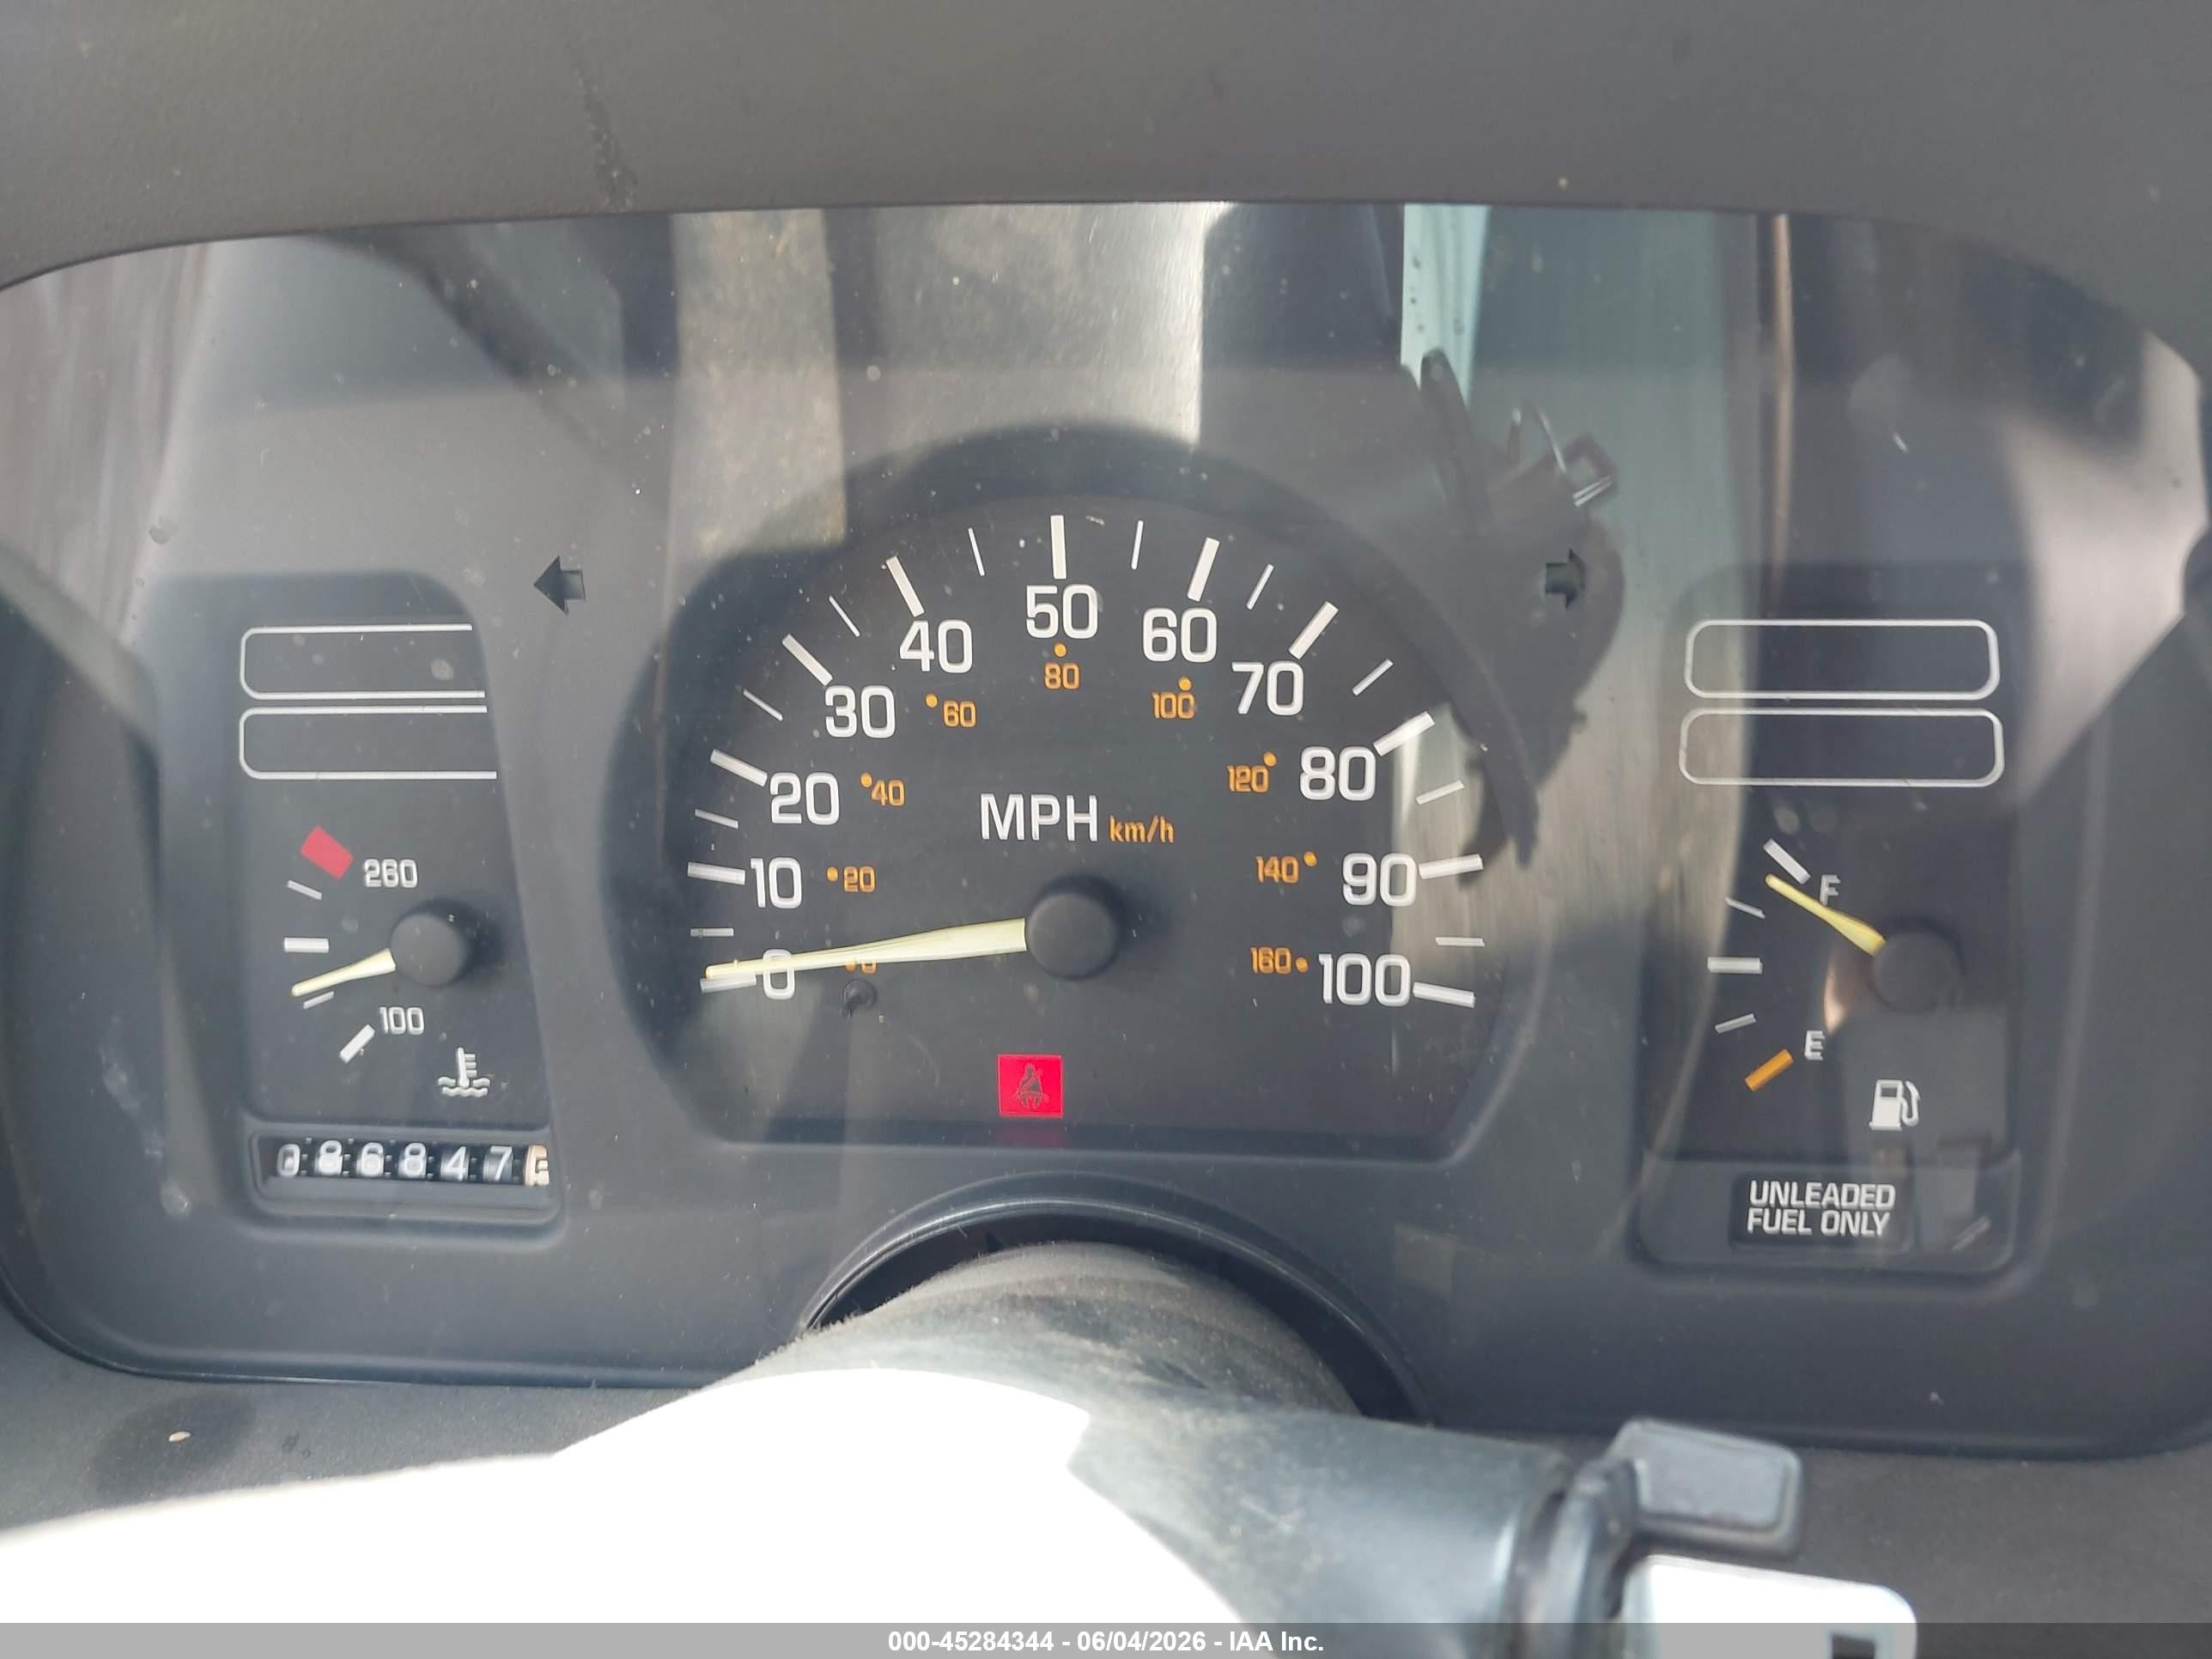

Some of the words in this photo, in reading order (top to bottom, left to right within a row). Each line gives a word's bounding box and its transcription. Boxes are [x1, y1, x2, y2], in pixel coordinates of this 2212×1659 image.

[1025, 583, 1099, 641] 50
[899, 618, 974, 674] 40
[1141, 606, 1218, 664] 60
[1043, 661, 1080, 690] 80
[1231, 659, 1304, 717] 70
[824, 684, 896, 739] 30
[942, 700, 977, 728] 60
[1152, 691, 1196, 720] 100
[1226, 764, 1269, 794] 120
[1298, 744, 1376, 802] 80
[769, 771, 841, 826] 20
[870, 779, 906, 807] 40
[980, 793, 1099, 842] MPH
[1109, 815, 1176, 844] km/h
[362, 858, 419, 889] 260
[749, 856, 803, 910] 10
[842, 865, 877, 894] 20
[1256, 854, 1299, 884] 140
[1341, 852, 1417, 908] 90
[1819, 873, 1842, 905] F
[762, 948, 796, 1000] 0
[1250, 946, 1293, 975] 160
[1318, 952, 1412, 1007] 100
[378, 1006, 425, 1036] 100
[1804, 1029, 1826, 1061] E
[1748, 1179, 1897, 1212] UNLEADED
[1746, 1207, 1814, 1236] FUEL
[1819, 1209, 1893, 1238] ONLY
